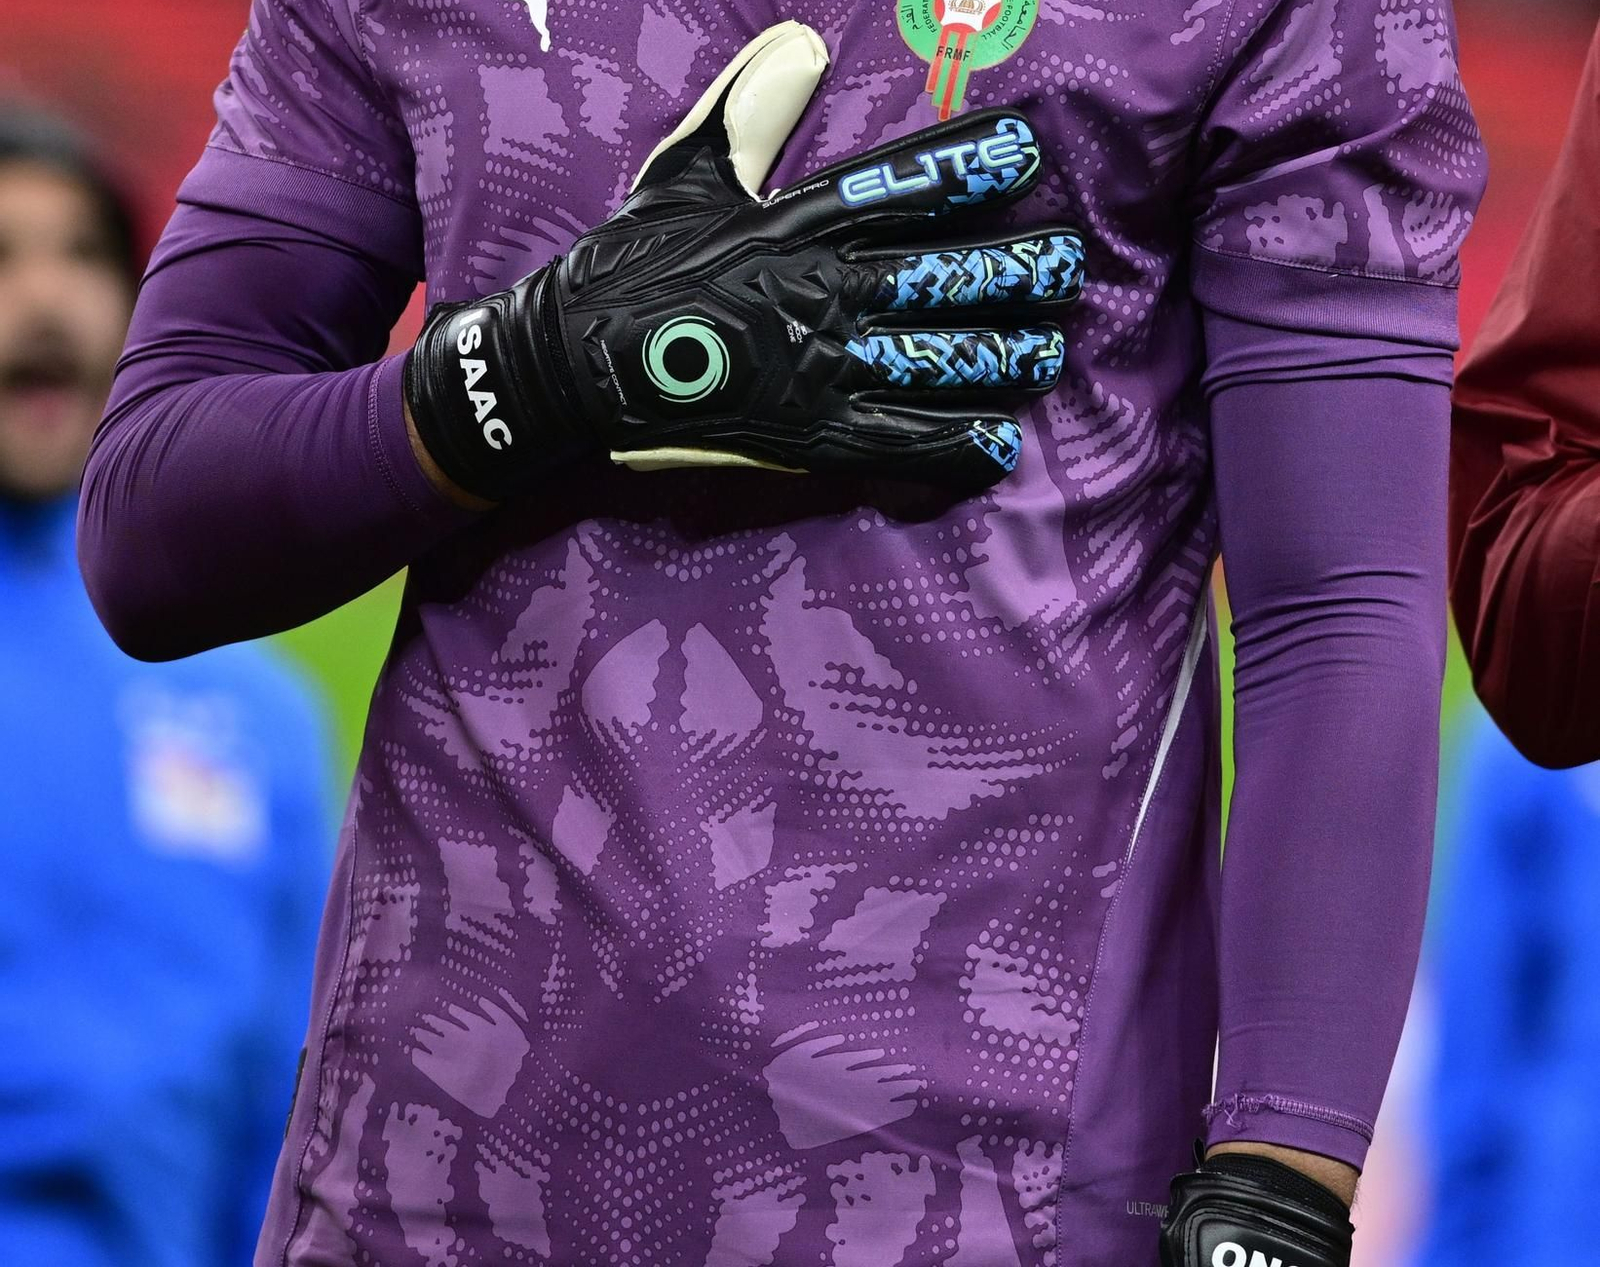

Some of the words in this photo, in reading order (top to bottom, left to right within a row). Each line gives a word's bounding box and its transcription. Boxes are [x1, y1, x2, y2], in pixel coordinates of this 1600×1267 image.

[982, 4, 1014, 41] FOOTBALL
[936, 45, 971, 62] FRMF
[839, 133, 1026, 207] ELITE
[762, 189, 802, 209] SUPER
[802, 179, 830, 193] PRO
[457, 310, 513, 450] ISAAC
[611, 373, 628, 406] CONTACT
[1211, 1241, 1300, 1267] ON
